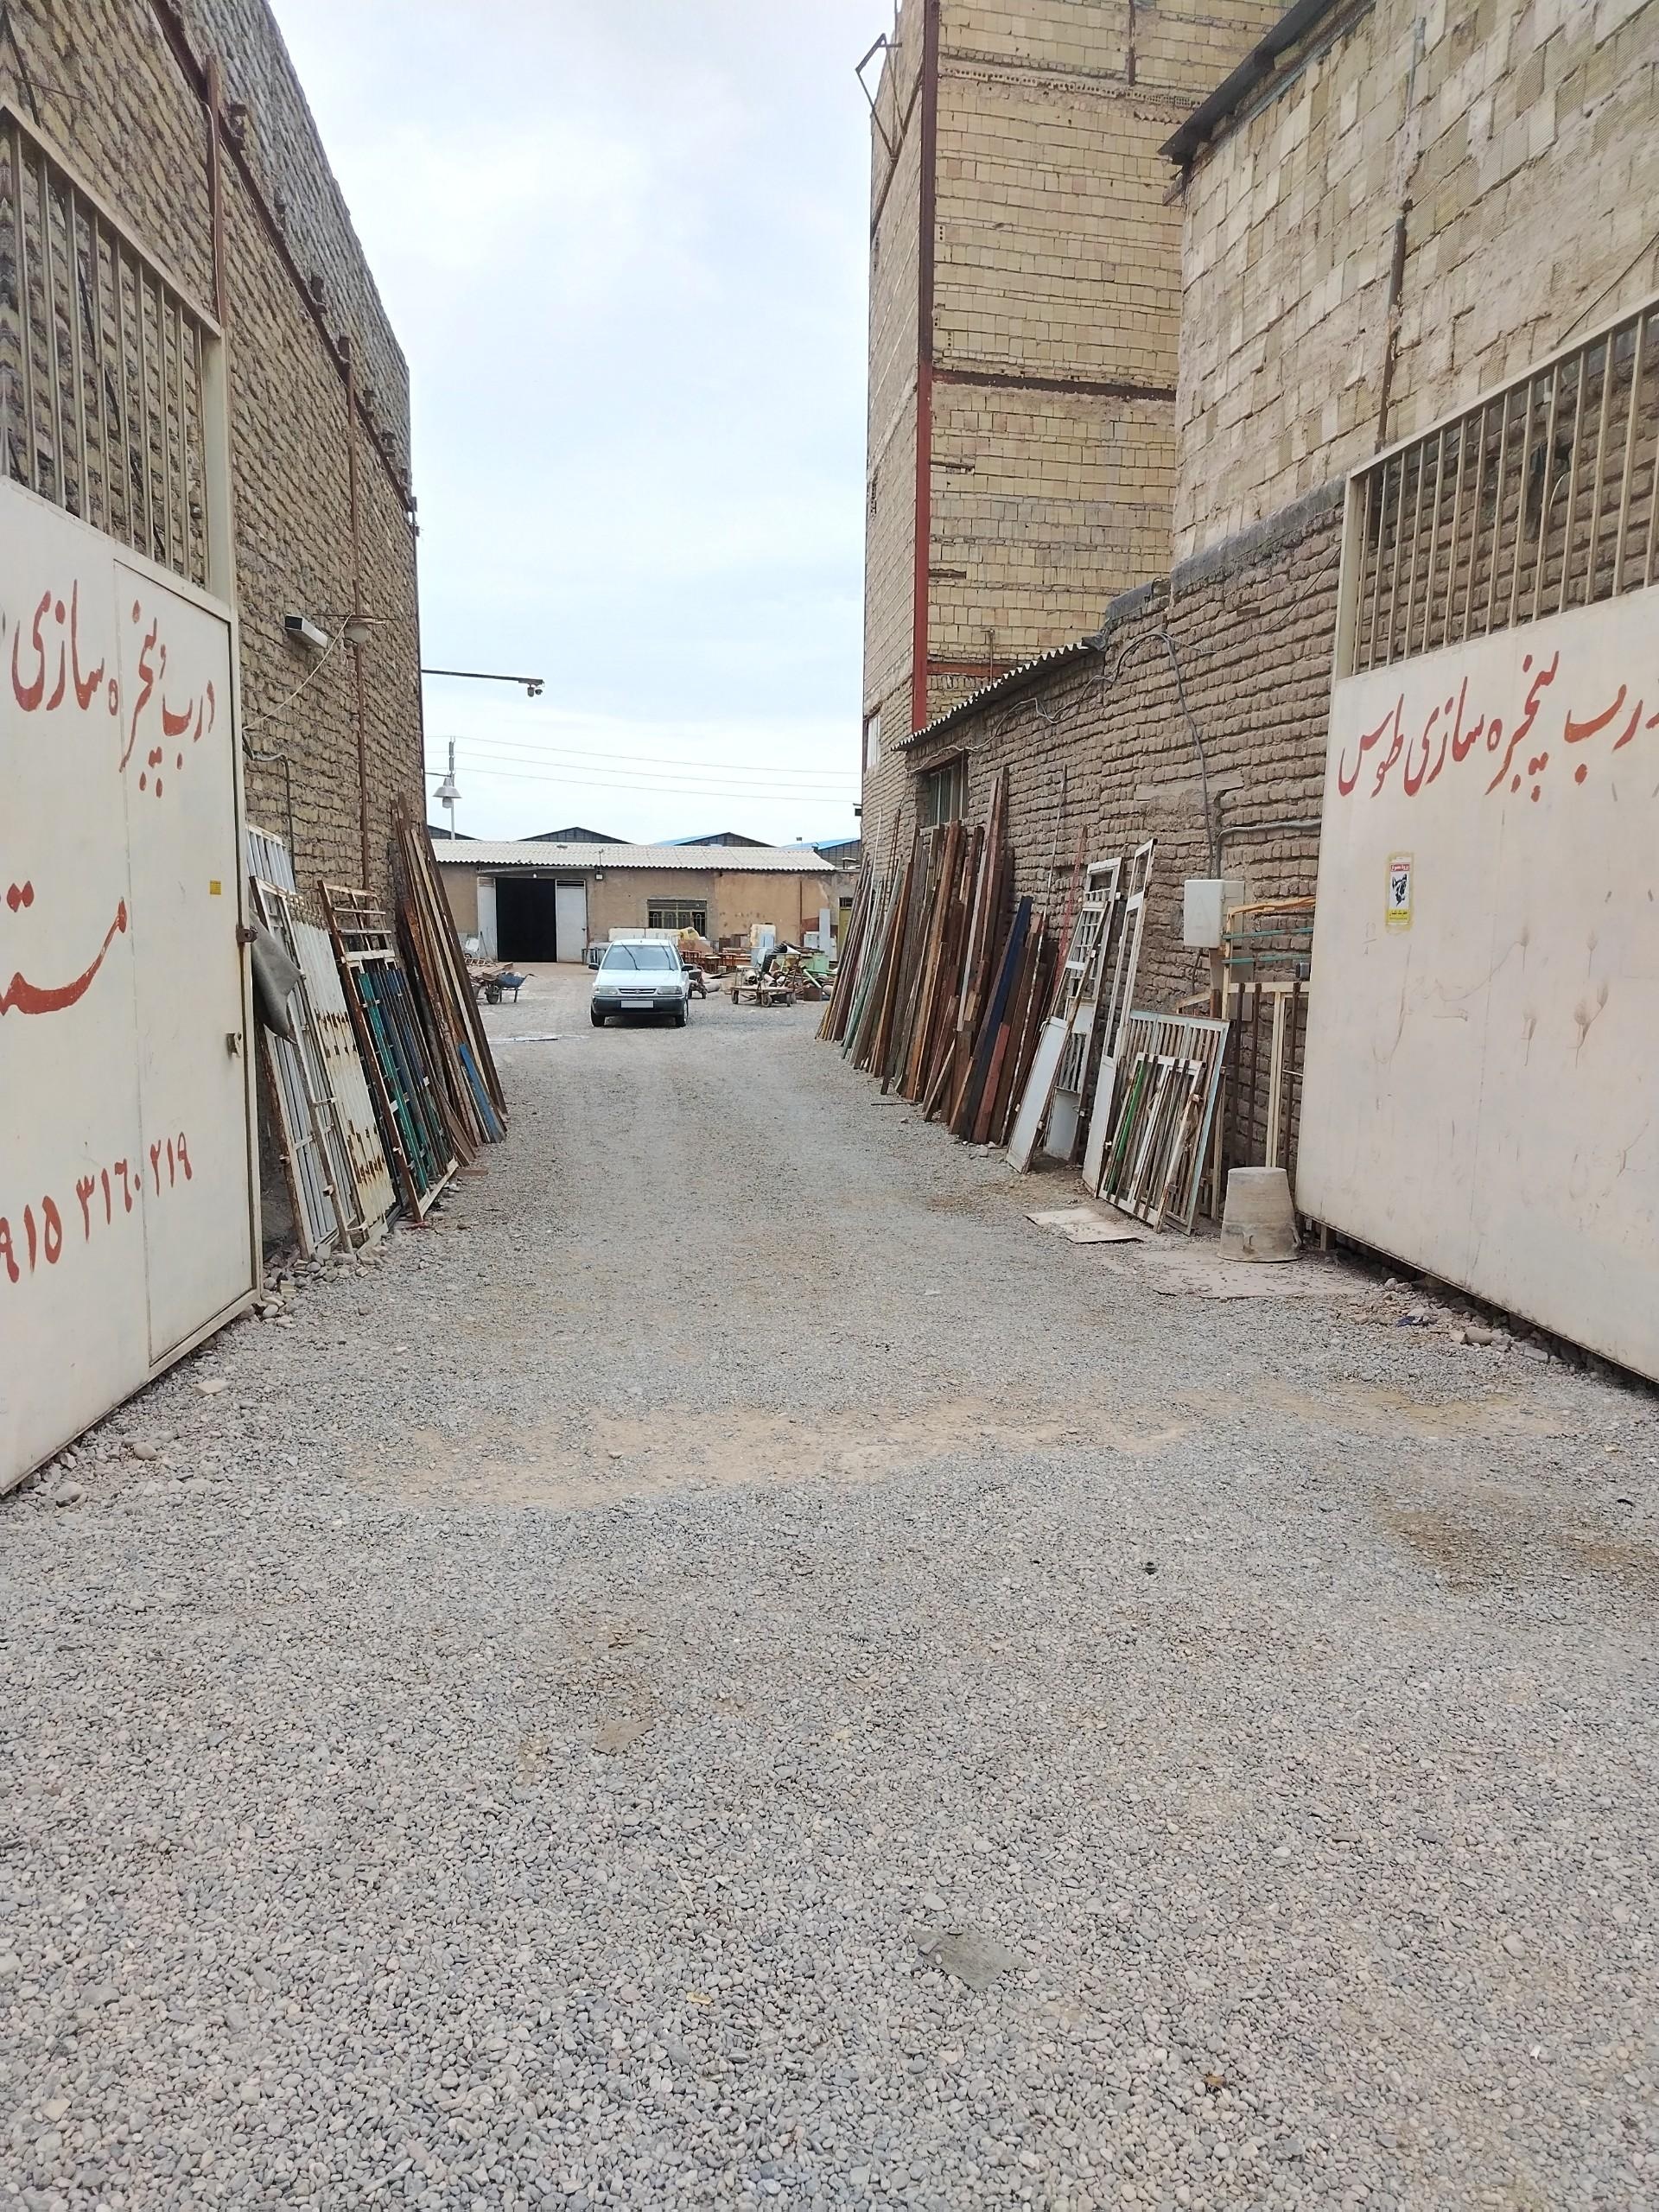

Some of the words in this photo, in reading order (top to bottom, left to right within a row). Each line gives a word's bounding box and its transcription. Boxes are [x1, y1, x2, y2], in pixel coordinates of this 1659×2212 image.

[11, 578, 105, 712] سازی
[161, 679, 215, 770] درب
[1338, 693, 1405, 799] طوس
[1403, 676, 1484, 797] سازی
